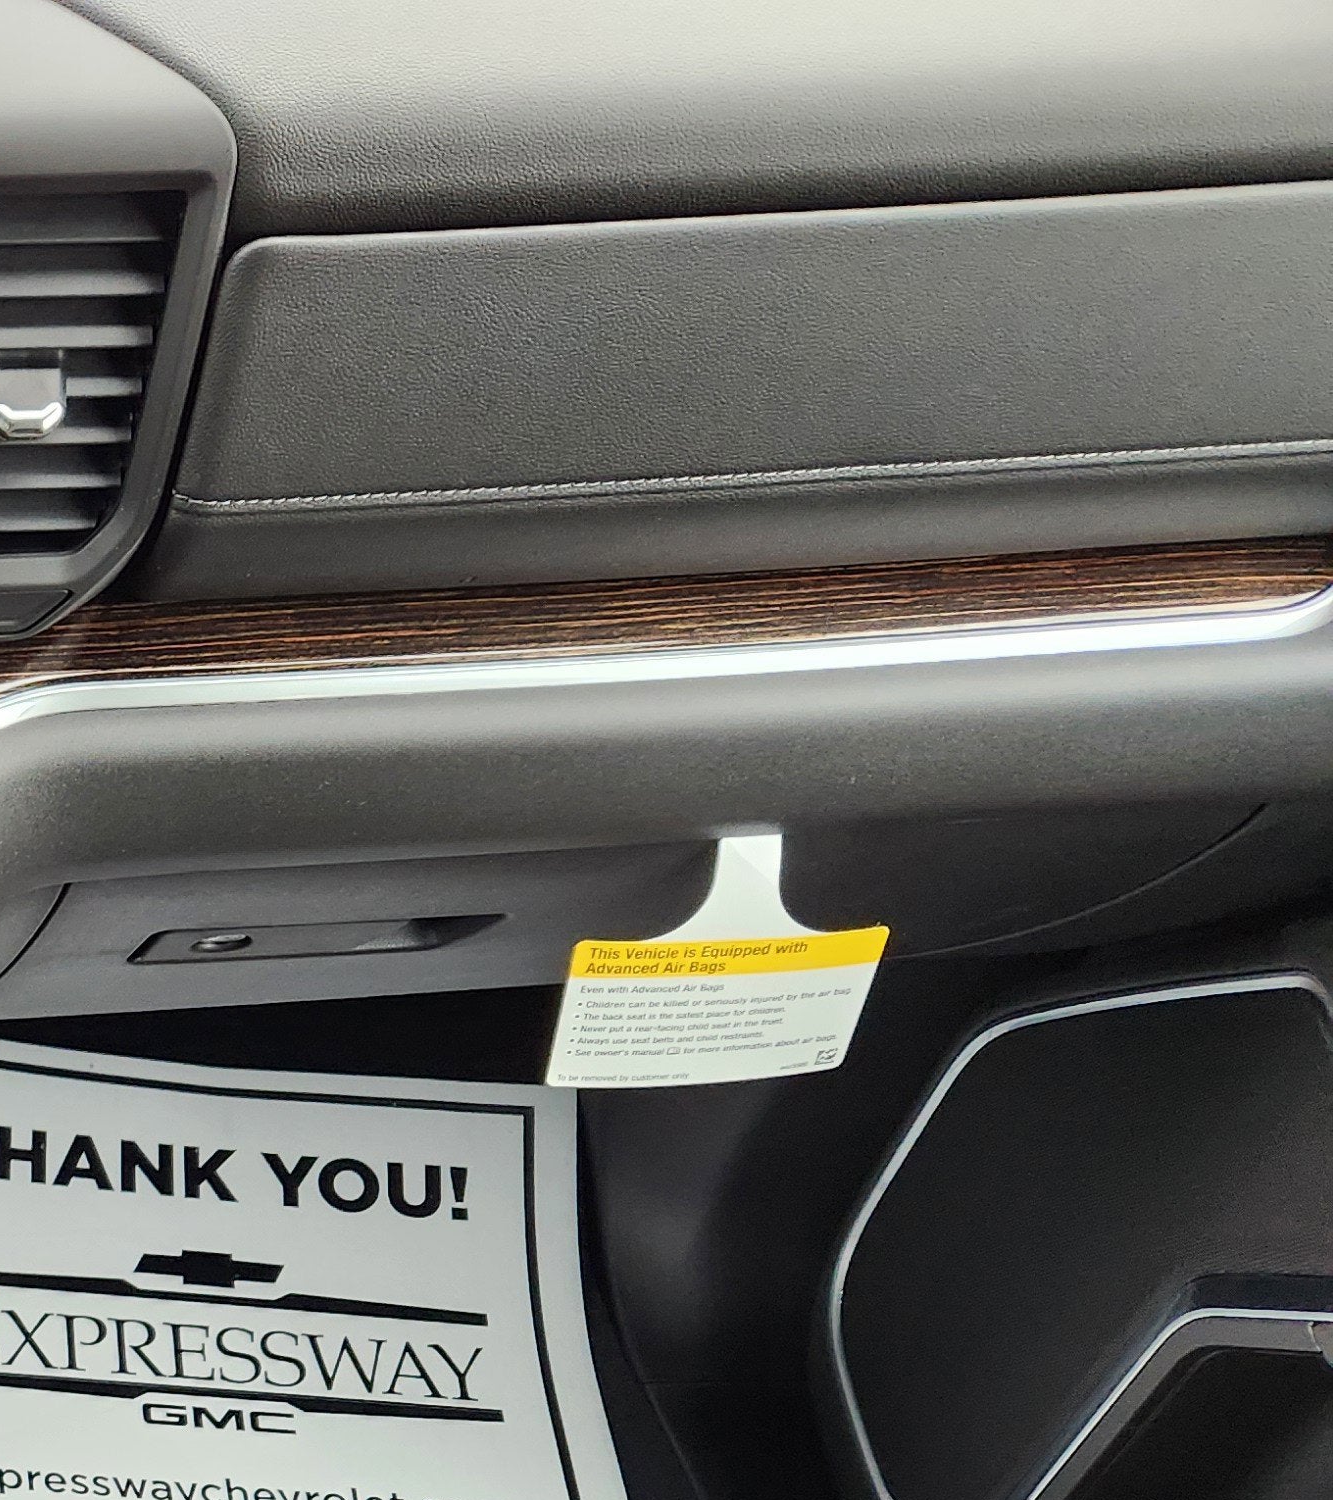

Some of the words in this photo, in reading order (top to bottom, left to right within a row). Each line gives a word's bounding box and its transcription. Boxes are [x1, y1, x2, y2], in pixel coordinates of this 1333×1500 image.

[590, 947, 620, 960] This
[625, 946, 678, 960] Vehicle
[684, 946, 696, 959] is
[701, 943, 771, 959] Equipped
[775, 941, 808, 954] with
[585, 961, 659, 974] Advanced
[663, 961, 684, 973] Air
[689, 961, 726, 975] Bags
[580, 985, 604, 993] Even
[607, 985, 628, 993] with
[630, 984, 680, 993] Advanced
[682, 984, 697, 992] Air
[700, 983, 725, 993] Bags
[586, 1000, 625, 1008] Children
[705, 998, 746, 1006] seriously
[584, 1012, 600, 1020] The
[602, 1012, 623, 1020] back
[608, 1025, 624, 1033] put
[687, 1022, 709, 1030] child
[577, 1037, 610, 1045] Always
[262, 1153, 469, 1221] YOU!
[142, 1404, 297, 1434] GMC
